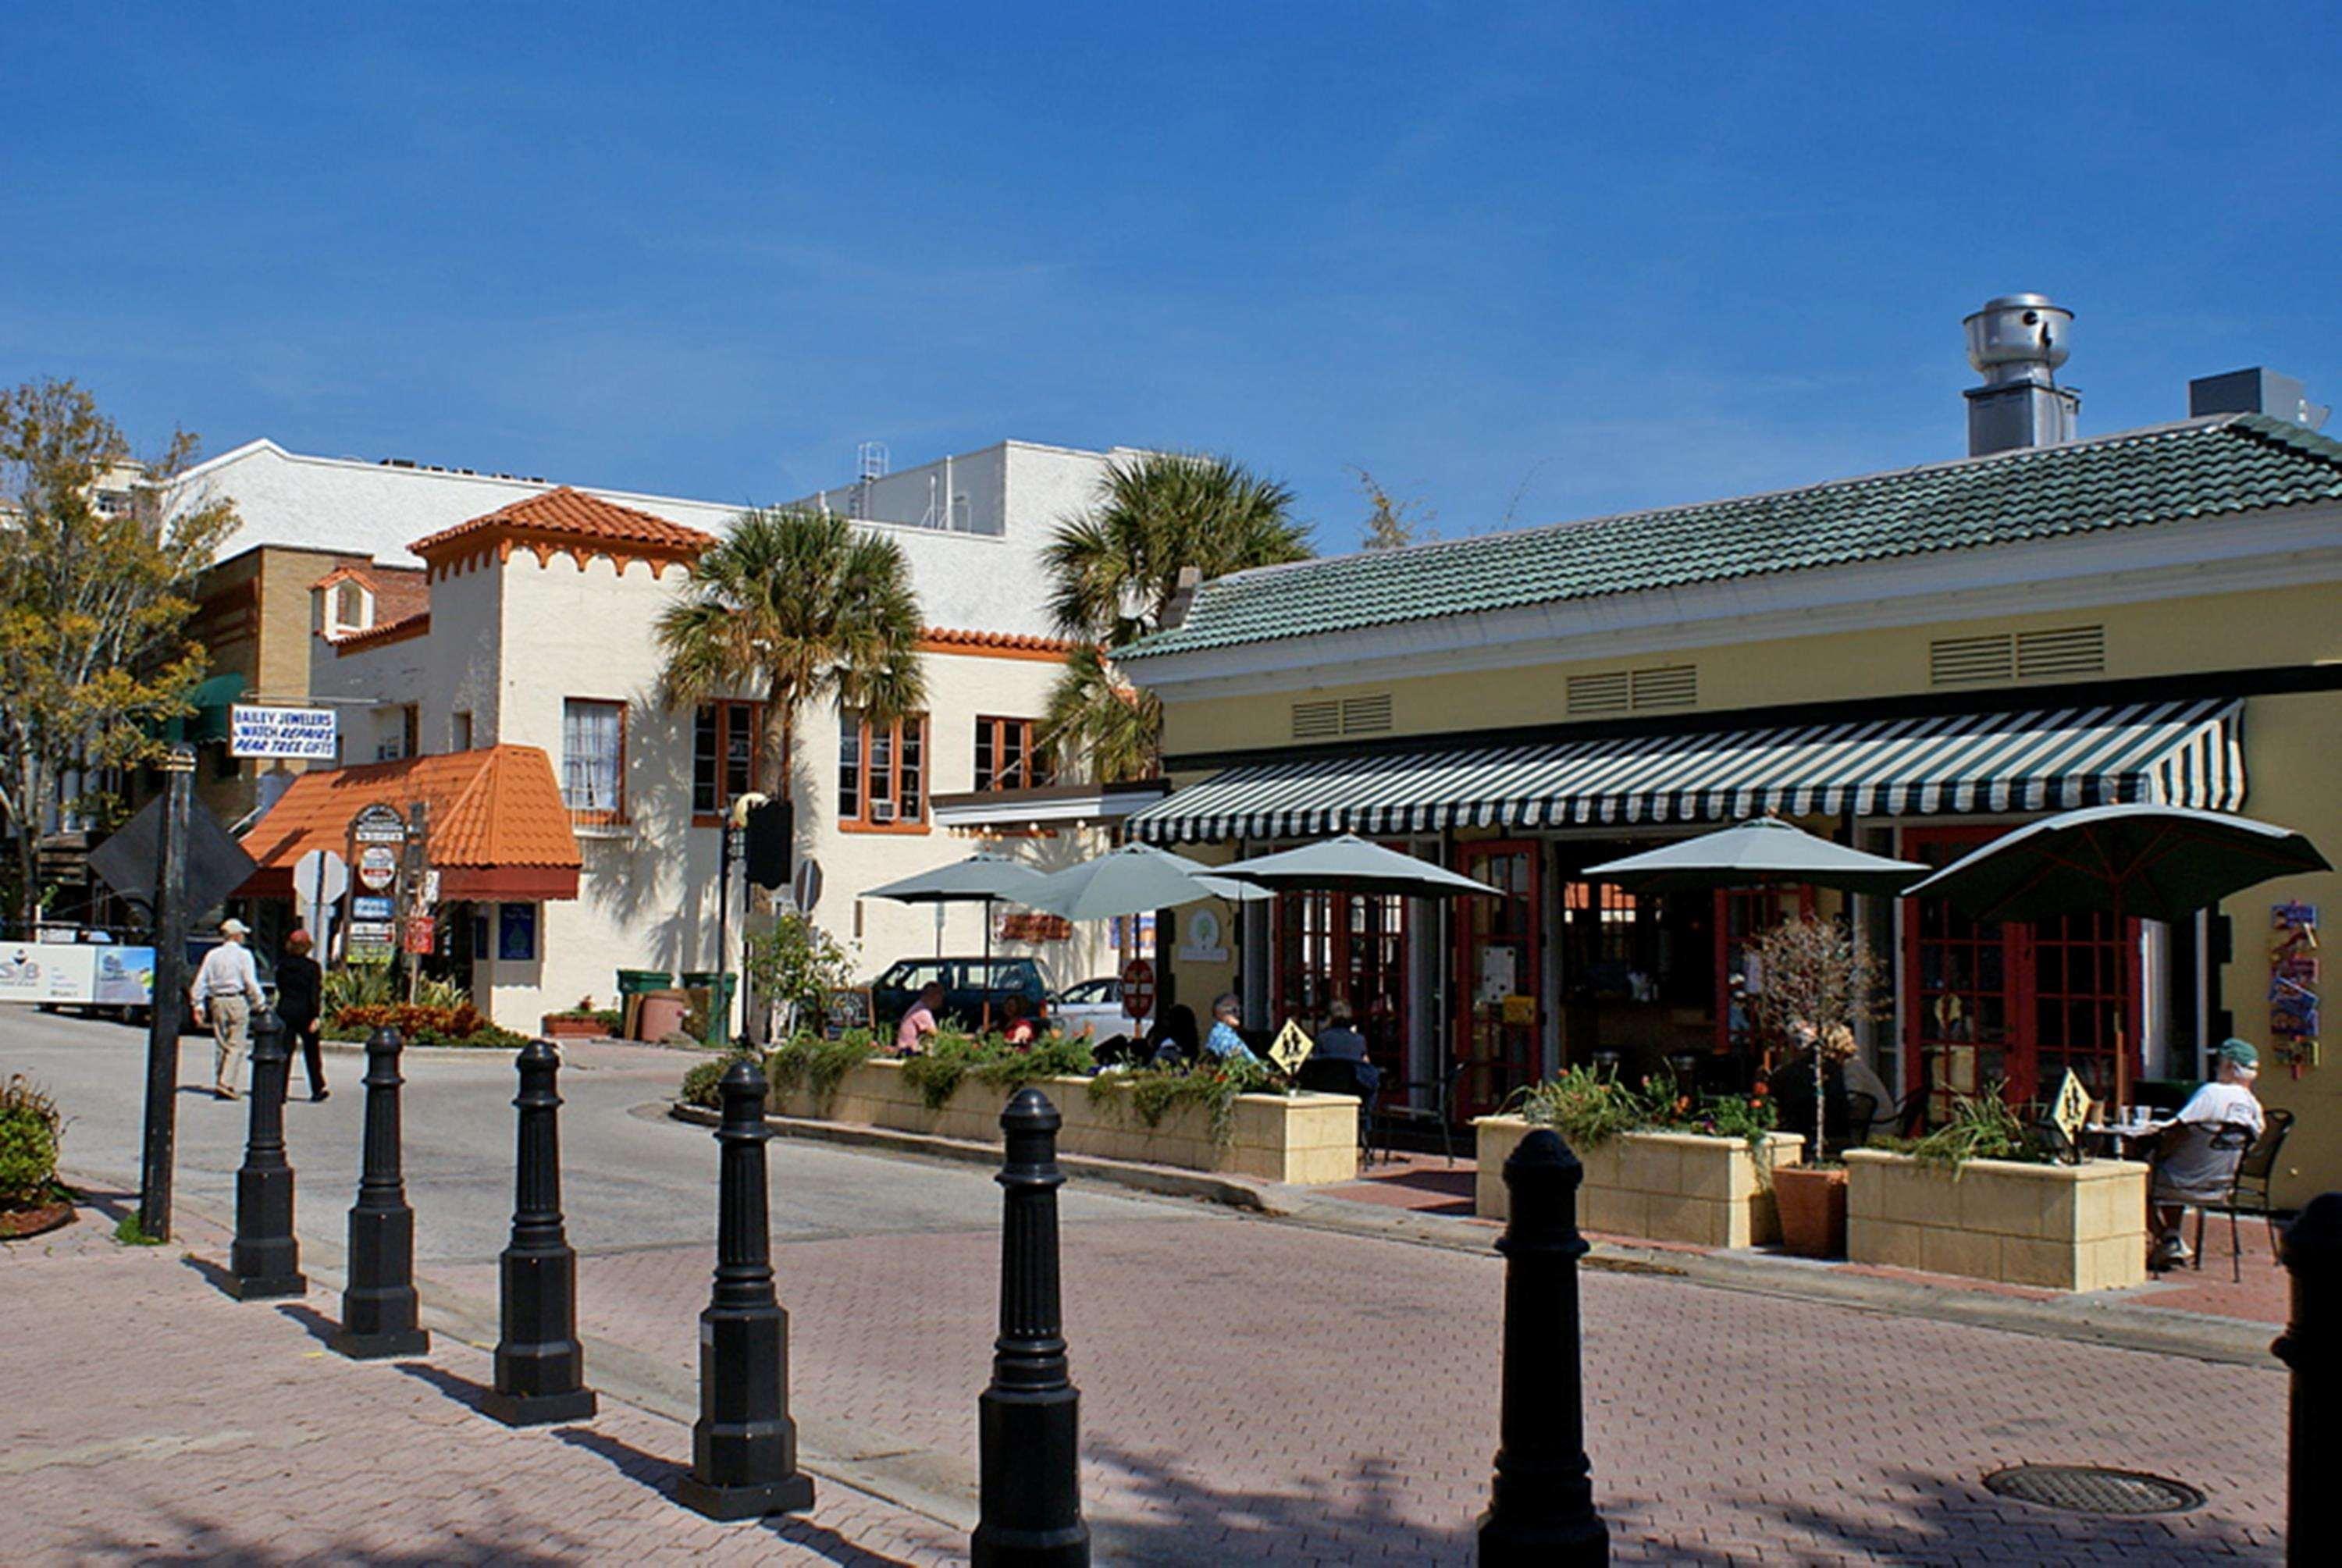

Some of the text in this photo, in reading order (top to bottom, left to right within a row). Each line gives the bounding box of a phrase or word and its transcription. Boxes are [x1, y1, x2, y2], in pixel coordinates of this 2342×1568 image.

[235, 711, 332, 726] BAILEY JEWELERS
[241, 726, 278, 738] WATCH
[279, 727, 333, 740] REPAIRS
[235, 739, 333, 755] PEAR TREE GIFTS
